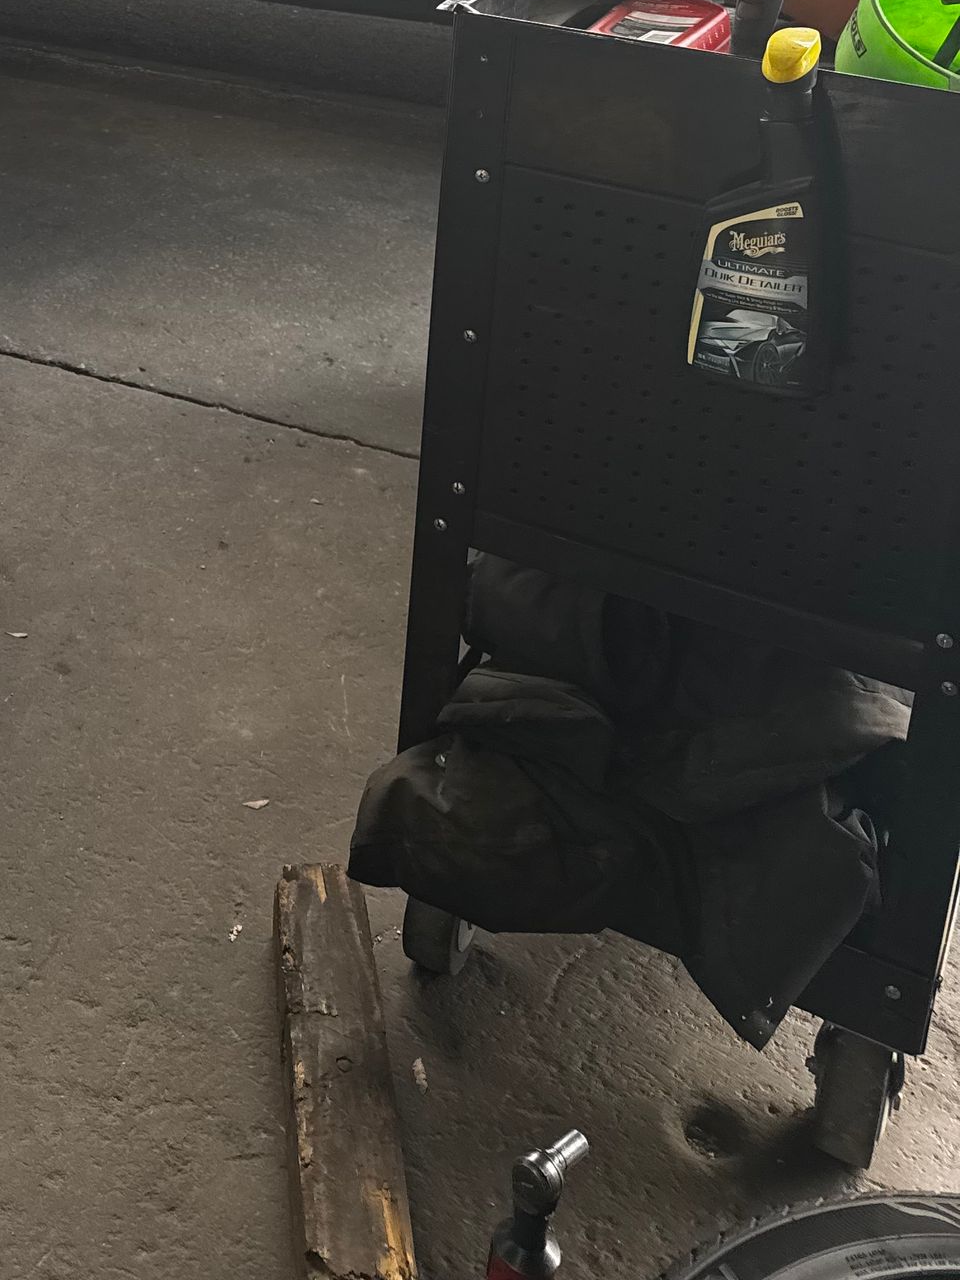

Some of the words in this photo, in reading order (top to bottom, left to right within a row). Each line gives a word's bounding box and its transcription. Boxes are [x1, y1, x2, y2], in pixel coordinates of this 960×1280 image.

[729, 230, 786, 253] Meguiar's
[718, 259, 785, 277] ULTIMATE
[738, 275, 803, 293] DETAILER
